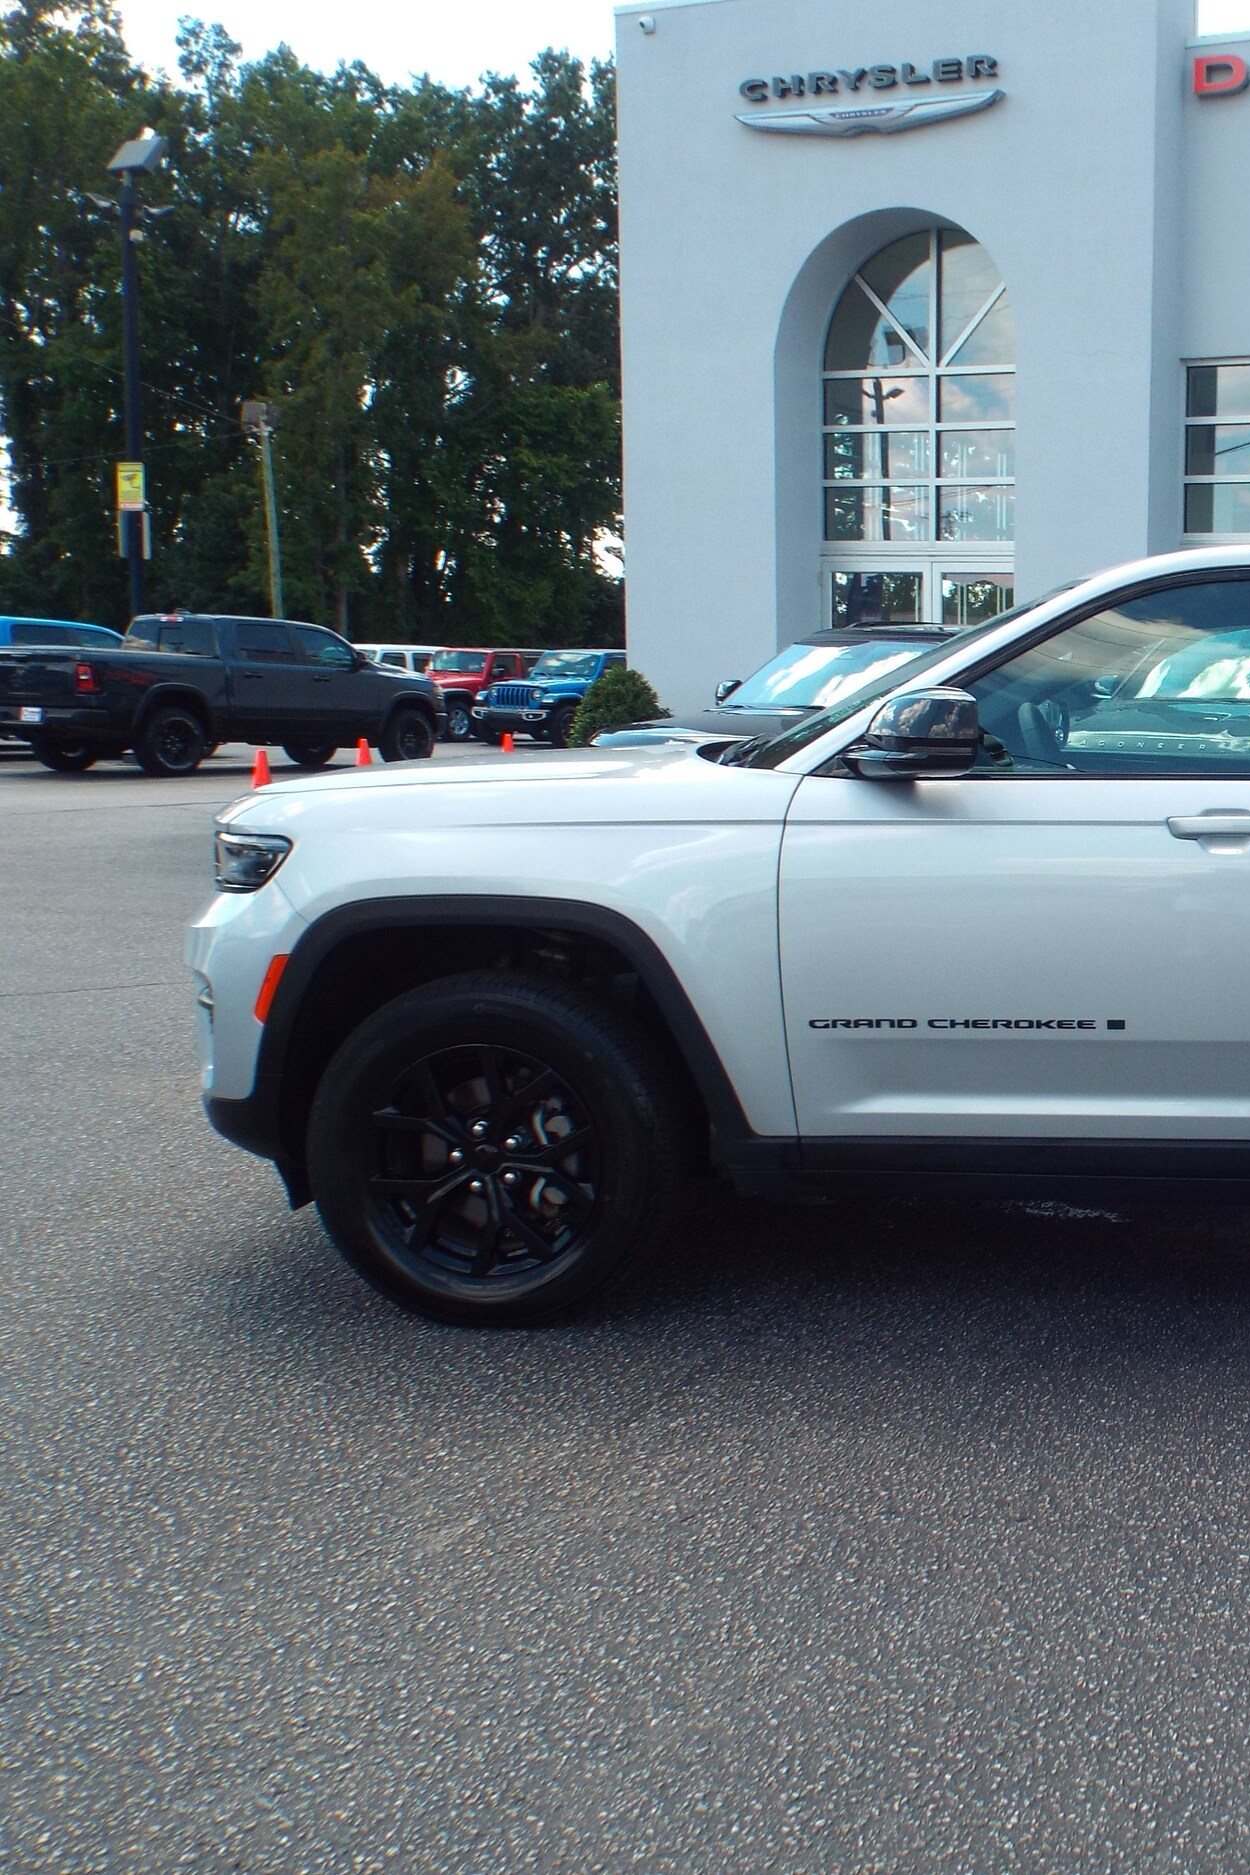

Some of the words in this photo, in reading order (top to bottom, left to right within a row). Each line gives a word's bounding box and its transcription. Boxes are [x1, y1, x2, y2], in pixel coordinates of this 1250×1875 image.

[739, 54, 998, 102] CHRYSLER
[835, 109, 887, 118] CHRYSLER
[1067, 739, 1205, 750] AGONEER
[808, 1018, 918, 1029] GRAND
[927, 1018, 1097, 1030] CHEROKEE
